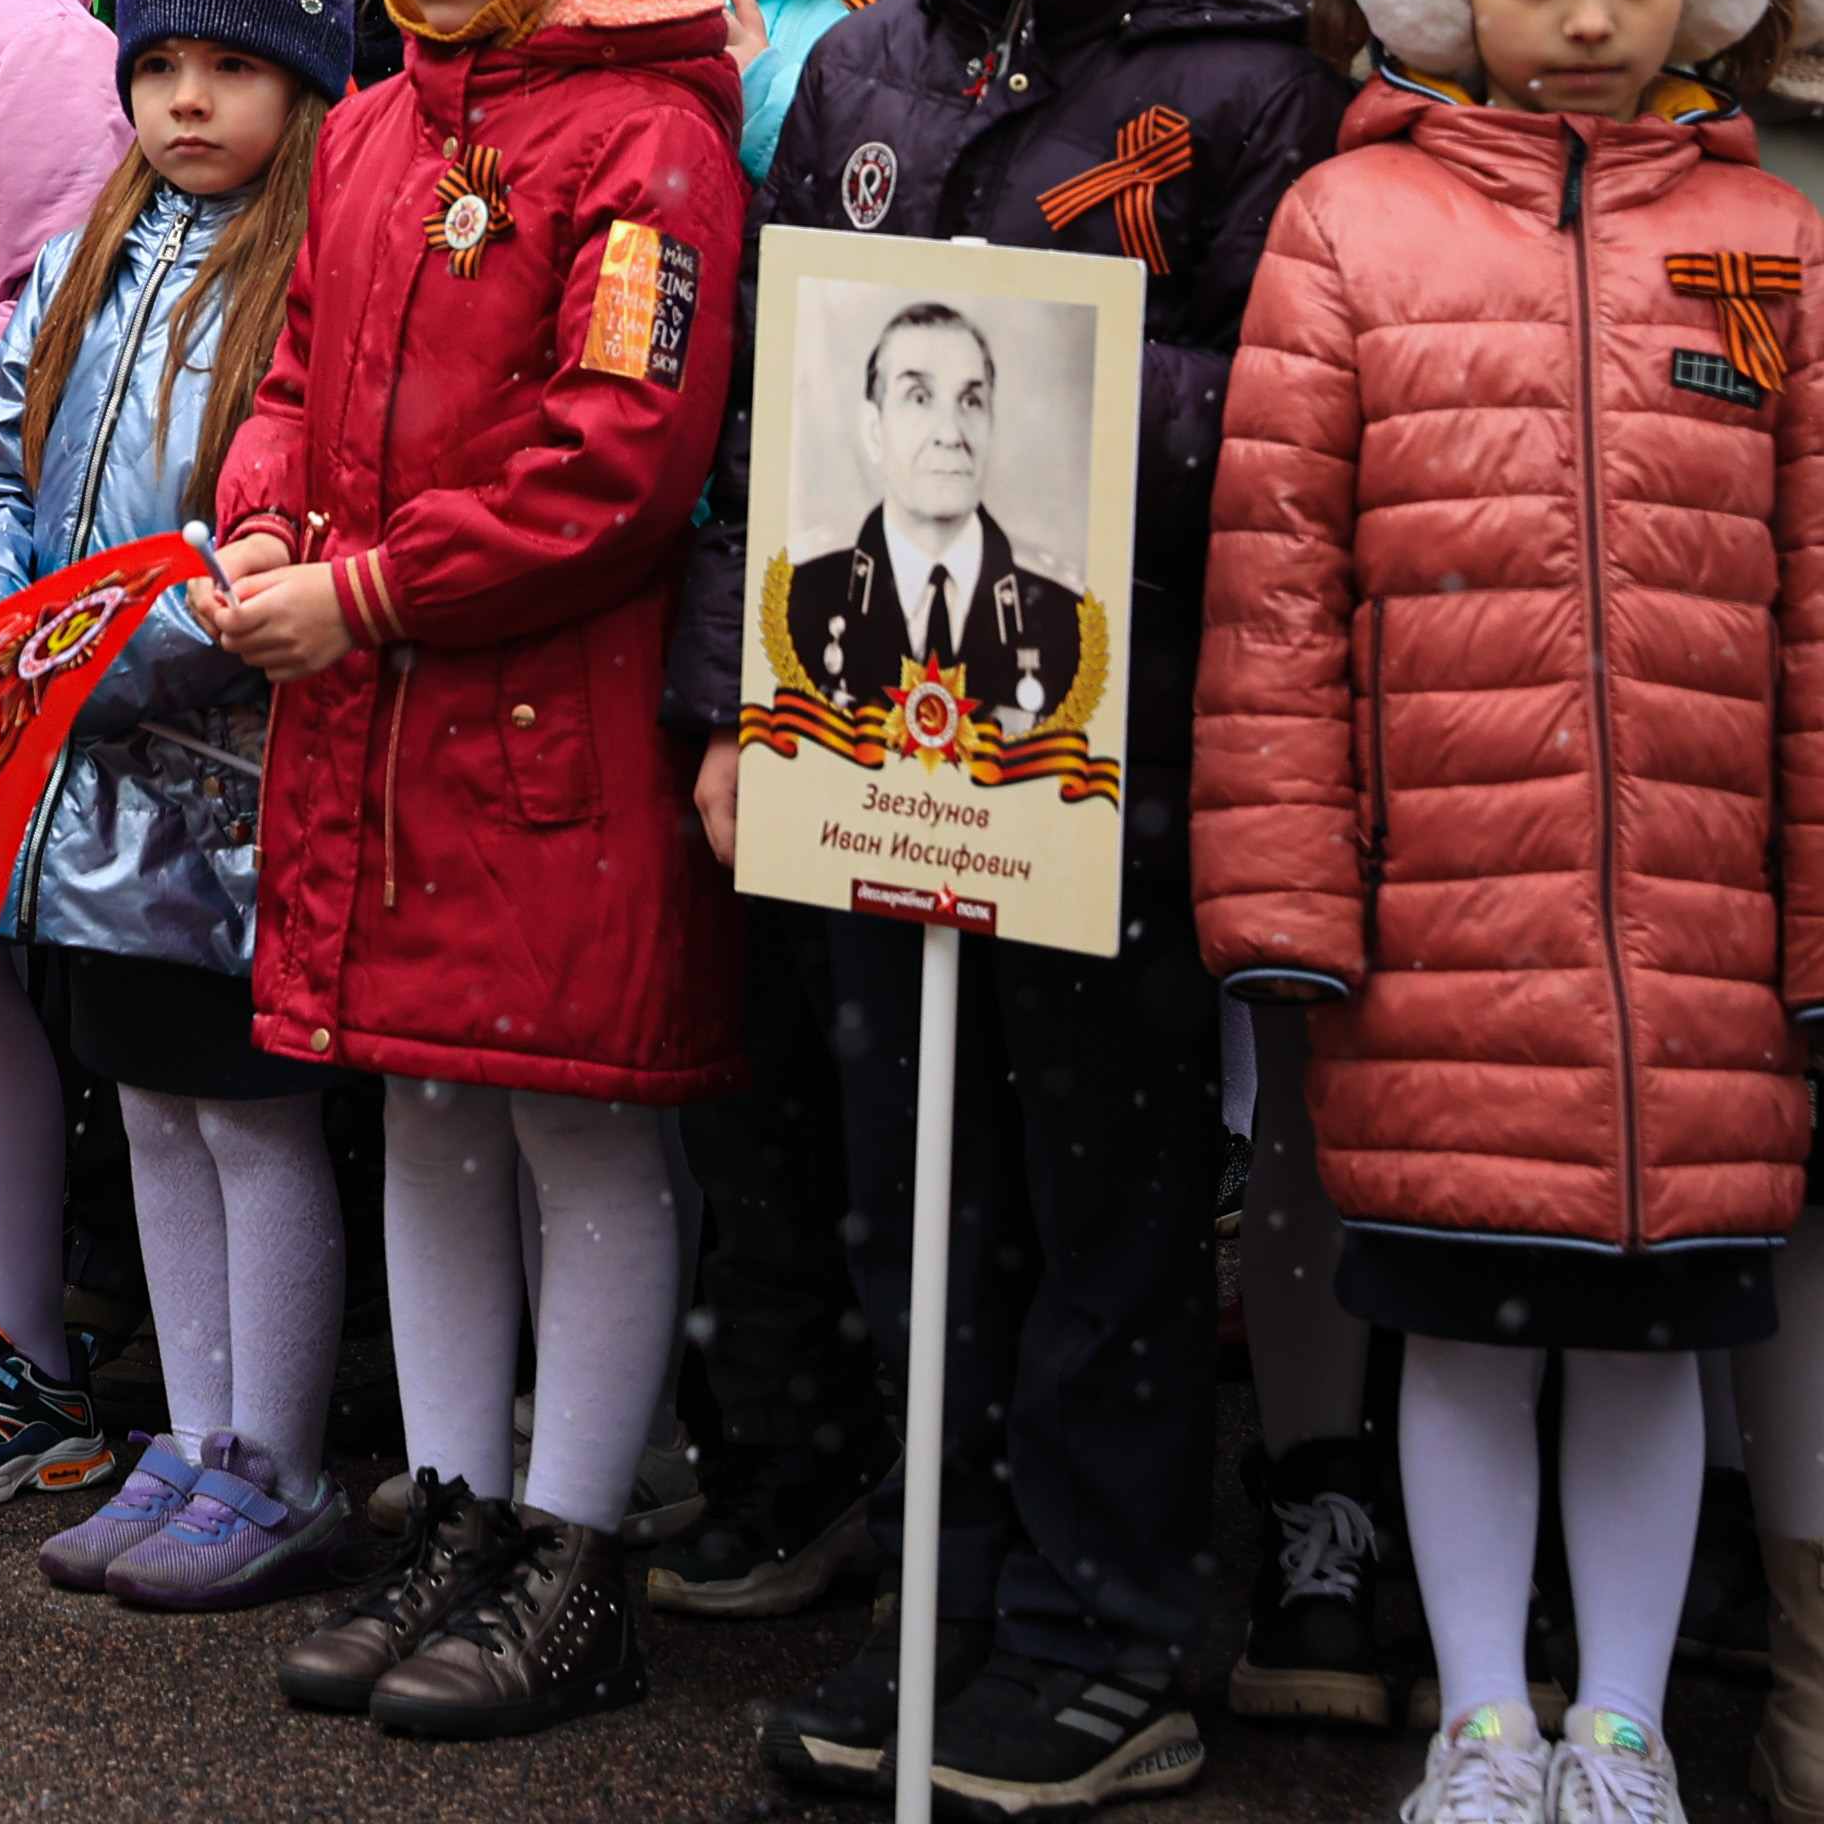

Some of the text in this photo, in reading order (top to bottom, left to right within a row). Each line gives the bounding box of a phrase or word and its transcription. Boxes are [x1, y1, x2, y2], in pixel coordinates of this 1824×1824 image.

[862, 783, 990, 828] Звездунов
[820, 820, 1032, 881] Иван Иосифович
